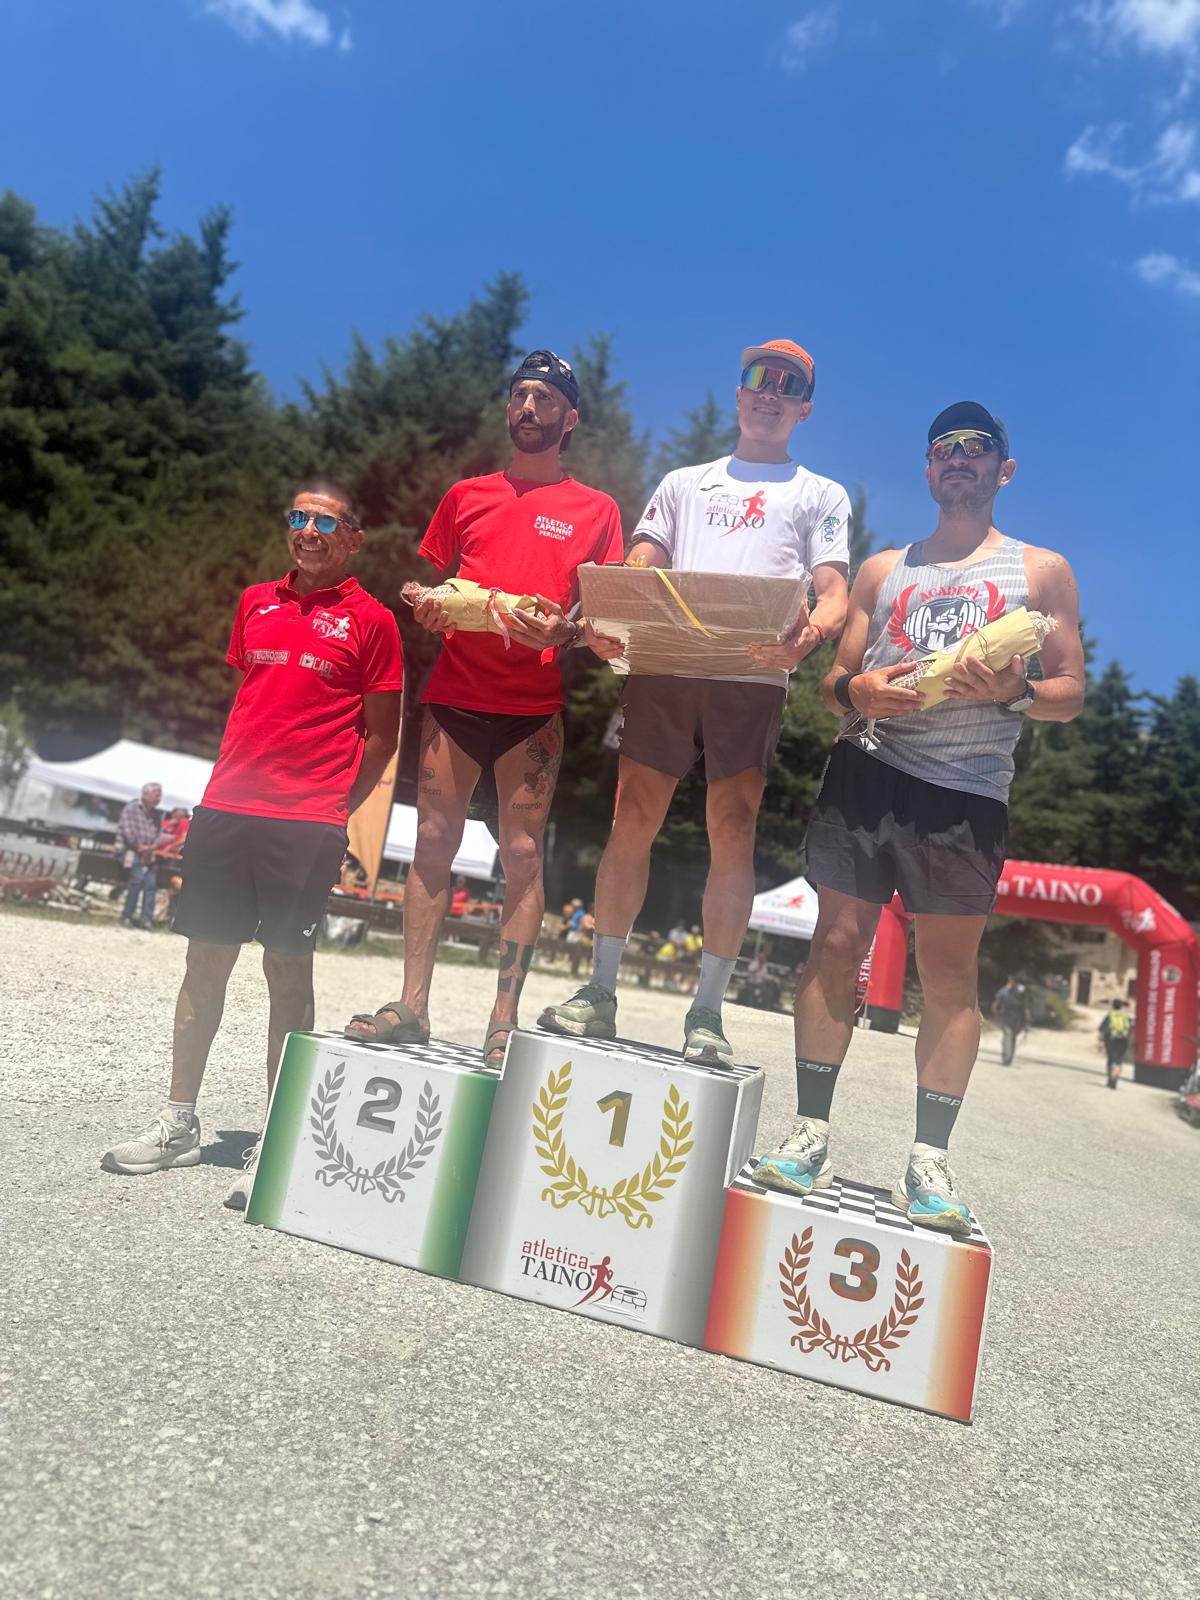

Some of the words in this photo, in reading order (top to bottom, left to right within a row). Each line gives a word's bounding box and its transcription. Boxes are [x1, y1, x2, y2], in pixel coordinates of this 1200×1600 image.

[706, 504, 741, 515] atletica
[533, 522, 573, 537] CAPANNE
[535, 515, 573, 530] ATLETICA
[706, 512, 765, 529] TAINO
[538, 529, 566, 541] PERUGIA
[919, 584, 982, 602] ACADEMY
[1011, 875, 1103, 906] TAINO
[1165, 987, 1176, 1013] TRAIL
[797, 1060, 832, 1073] cep
[356, 1076, 402, 1134] 2
[926, 1092, 961, 1106] cep
[597, 1089, 633, 1147] 1
[522, 1239, 589, 1270] atletica
[520, 1255, 592, 1291] TAINO
[829, 1237, 881, 1302] 3
